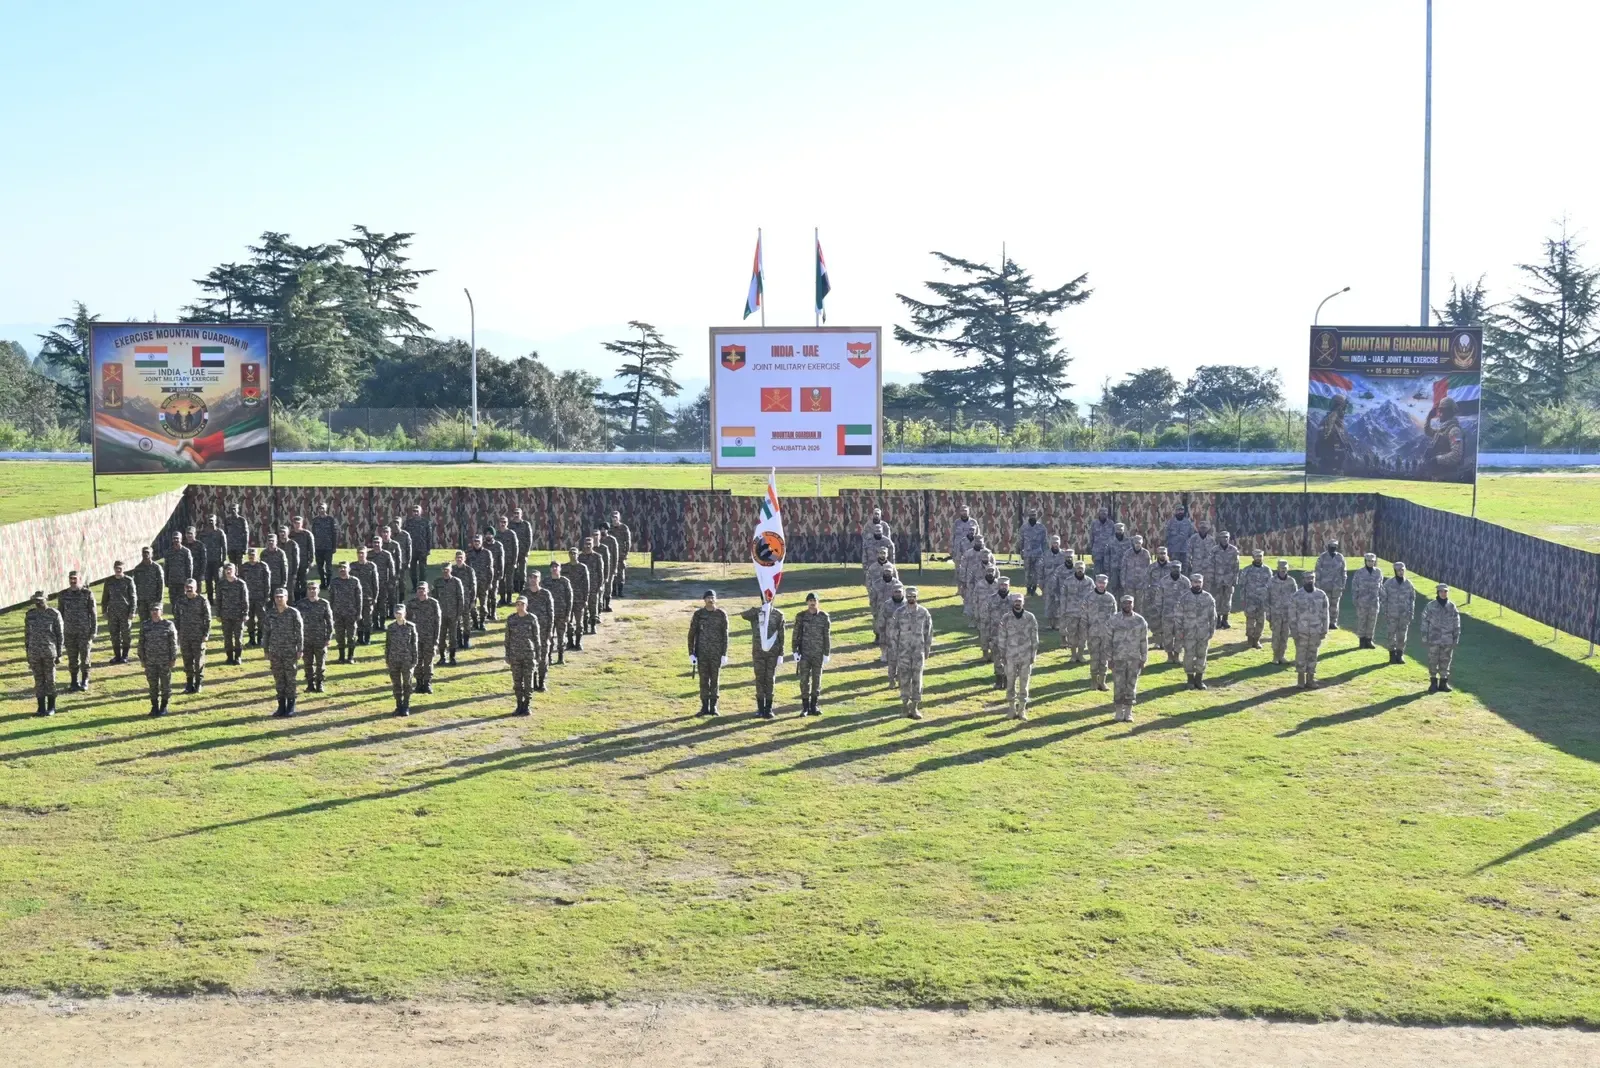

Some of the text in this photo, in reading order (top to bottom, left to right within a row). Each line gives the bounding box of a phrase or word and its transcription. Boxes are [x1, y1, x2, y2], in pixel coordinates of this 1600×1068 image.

[114, 328, 249, 351] EXERCISE MOUNTAIN GUARDIAN III
[1341, 336, 1449, 352] MOUNTAIN GUARDIAN III
[771, 345, 794, 357] INDIA
[802, 345, 819, 357] UAE
[1351, 355, 1367, 363] INDIA
[158, 368, 181, 376] INDIA
[189, 368, 206, 376] UAE
[752, 363, 772, 371] JOINT
[774, 363, 806, 371] MILITARY
